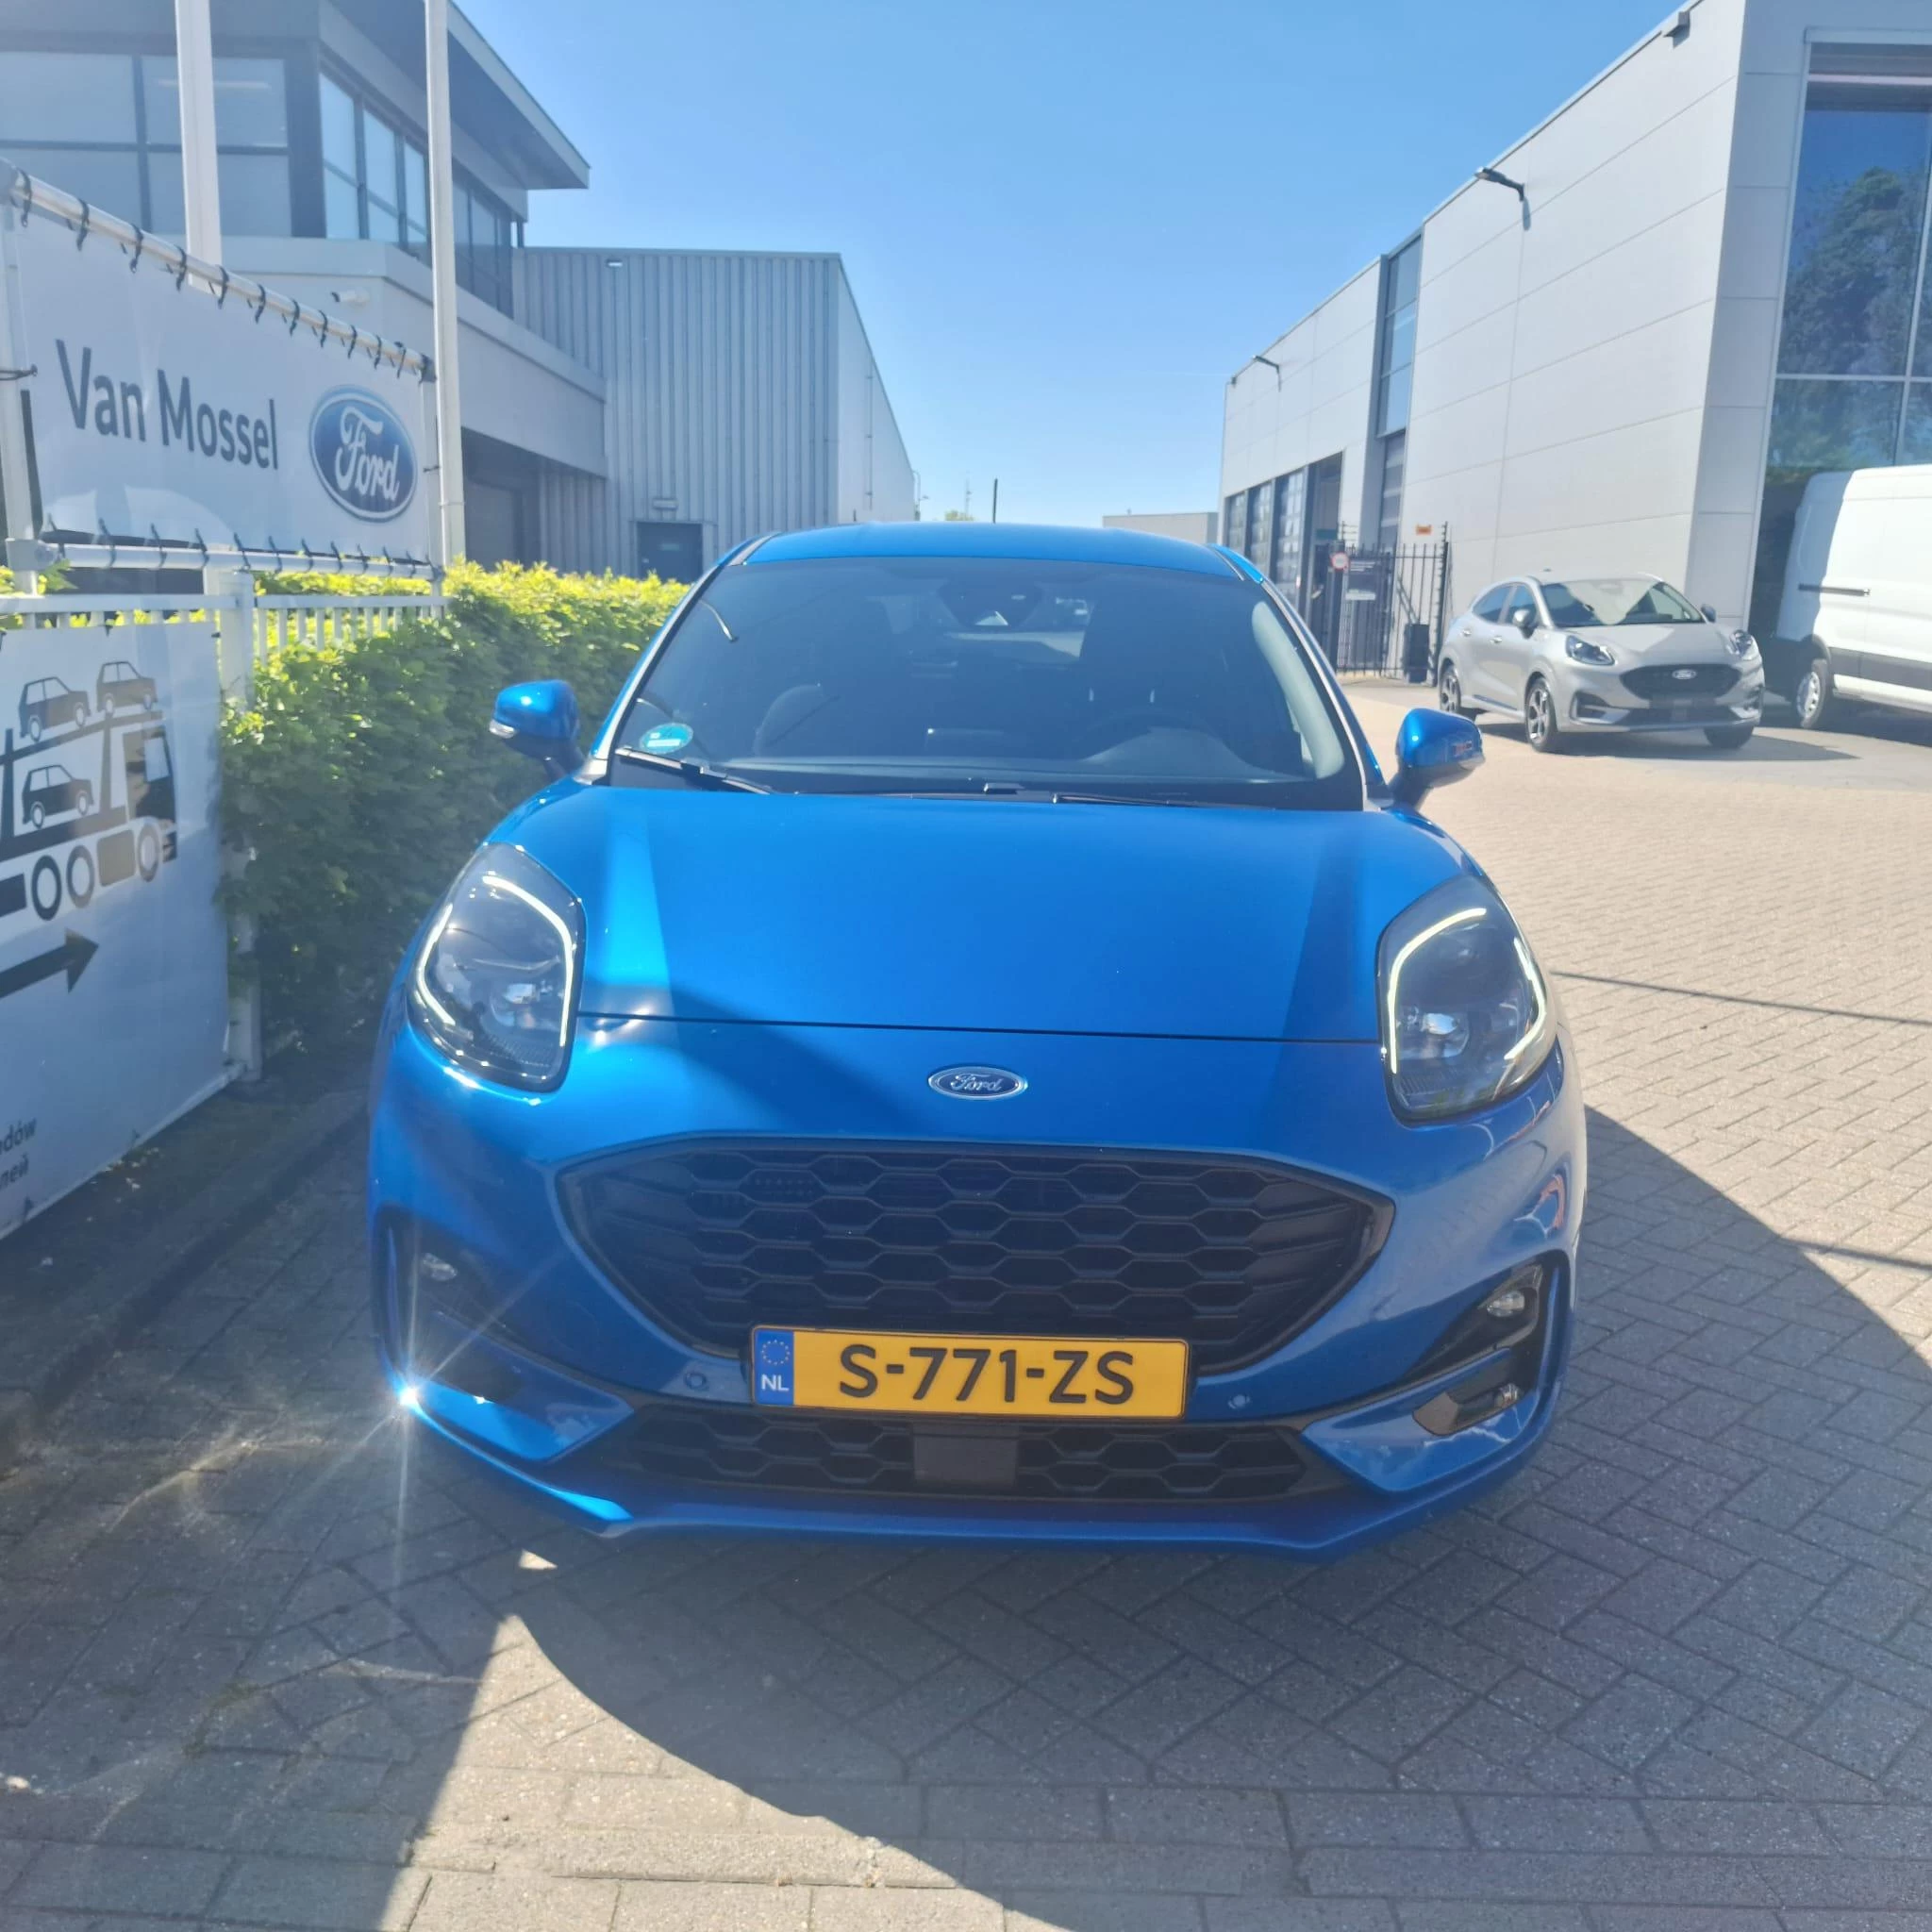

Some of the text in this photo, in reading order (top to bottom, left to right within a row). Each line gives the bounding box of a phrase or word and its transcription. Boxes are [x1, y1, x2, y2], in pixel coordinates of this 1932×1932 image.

[56, 339, 279, 471] Van Mossel
[334, 405, 401, 504] Ford
[950, 1072, 1004, 1091] Ford
[760, 1374, 790, 1392] NL
[839, 1343, 1135, 1405] S-771-ZS
